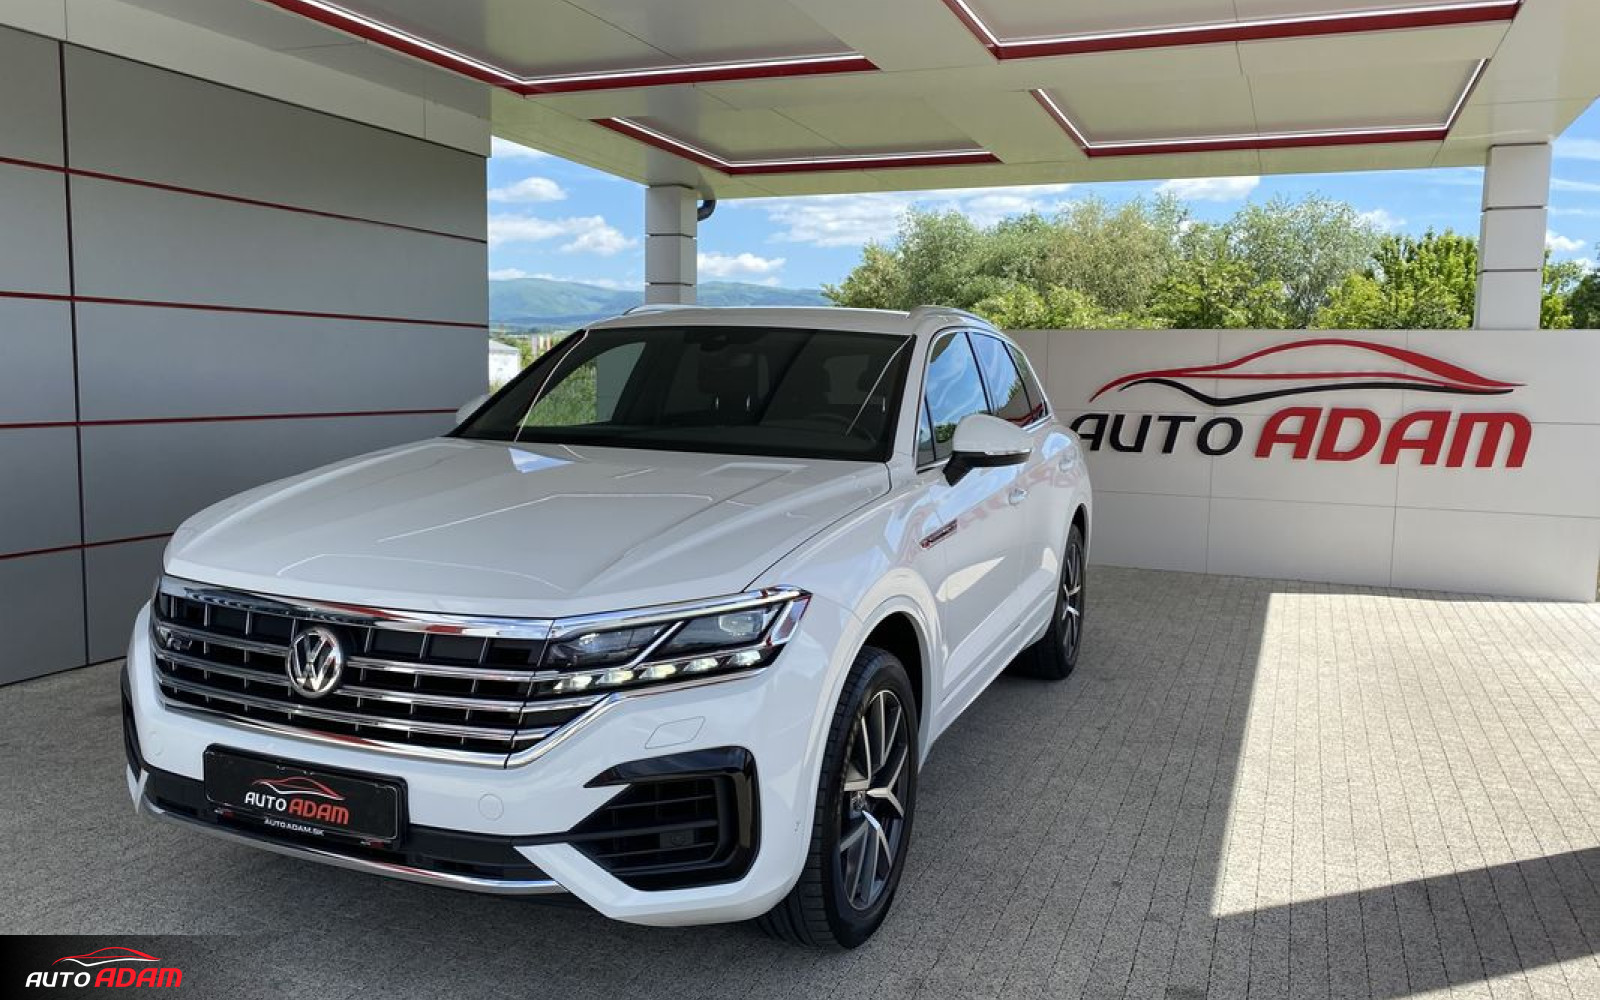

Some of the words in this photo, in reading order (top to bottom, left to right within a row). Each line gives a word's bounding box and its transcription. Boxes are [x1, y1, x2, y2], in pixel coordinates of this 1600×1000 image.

[1070, 412, 1243, 456] AUTO
[1254, 406, 1532, 468] ADAM
[244, 791, 287, 812] AUTO
[288, 797, 349, 825] ADAM
